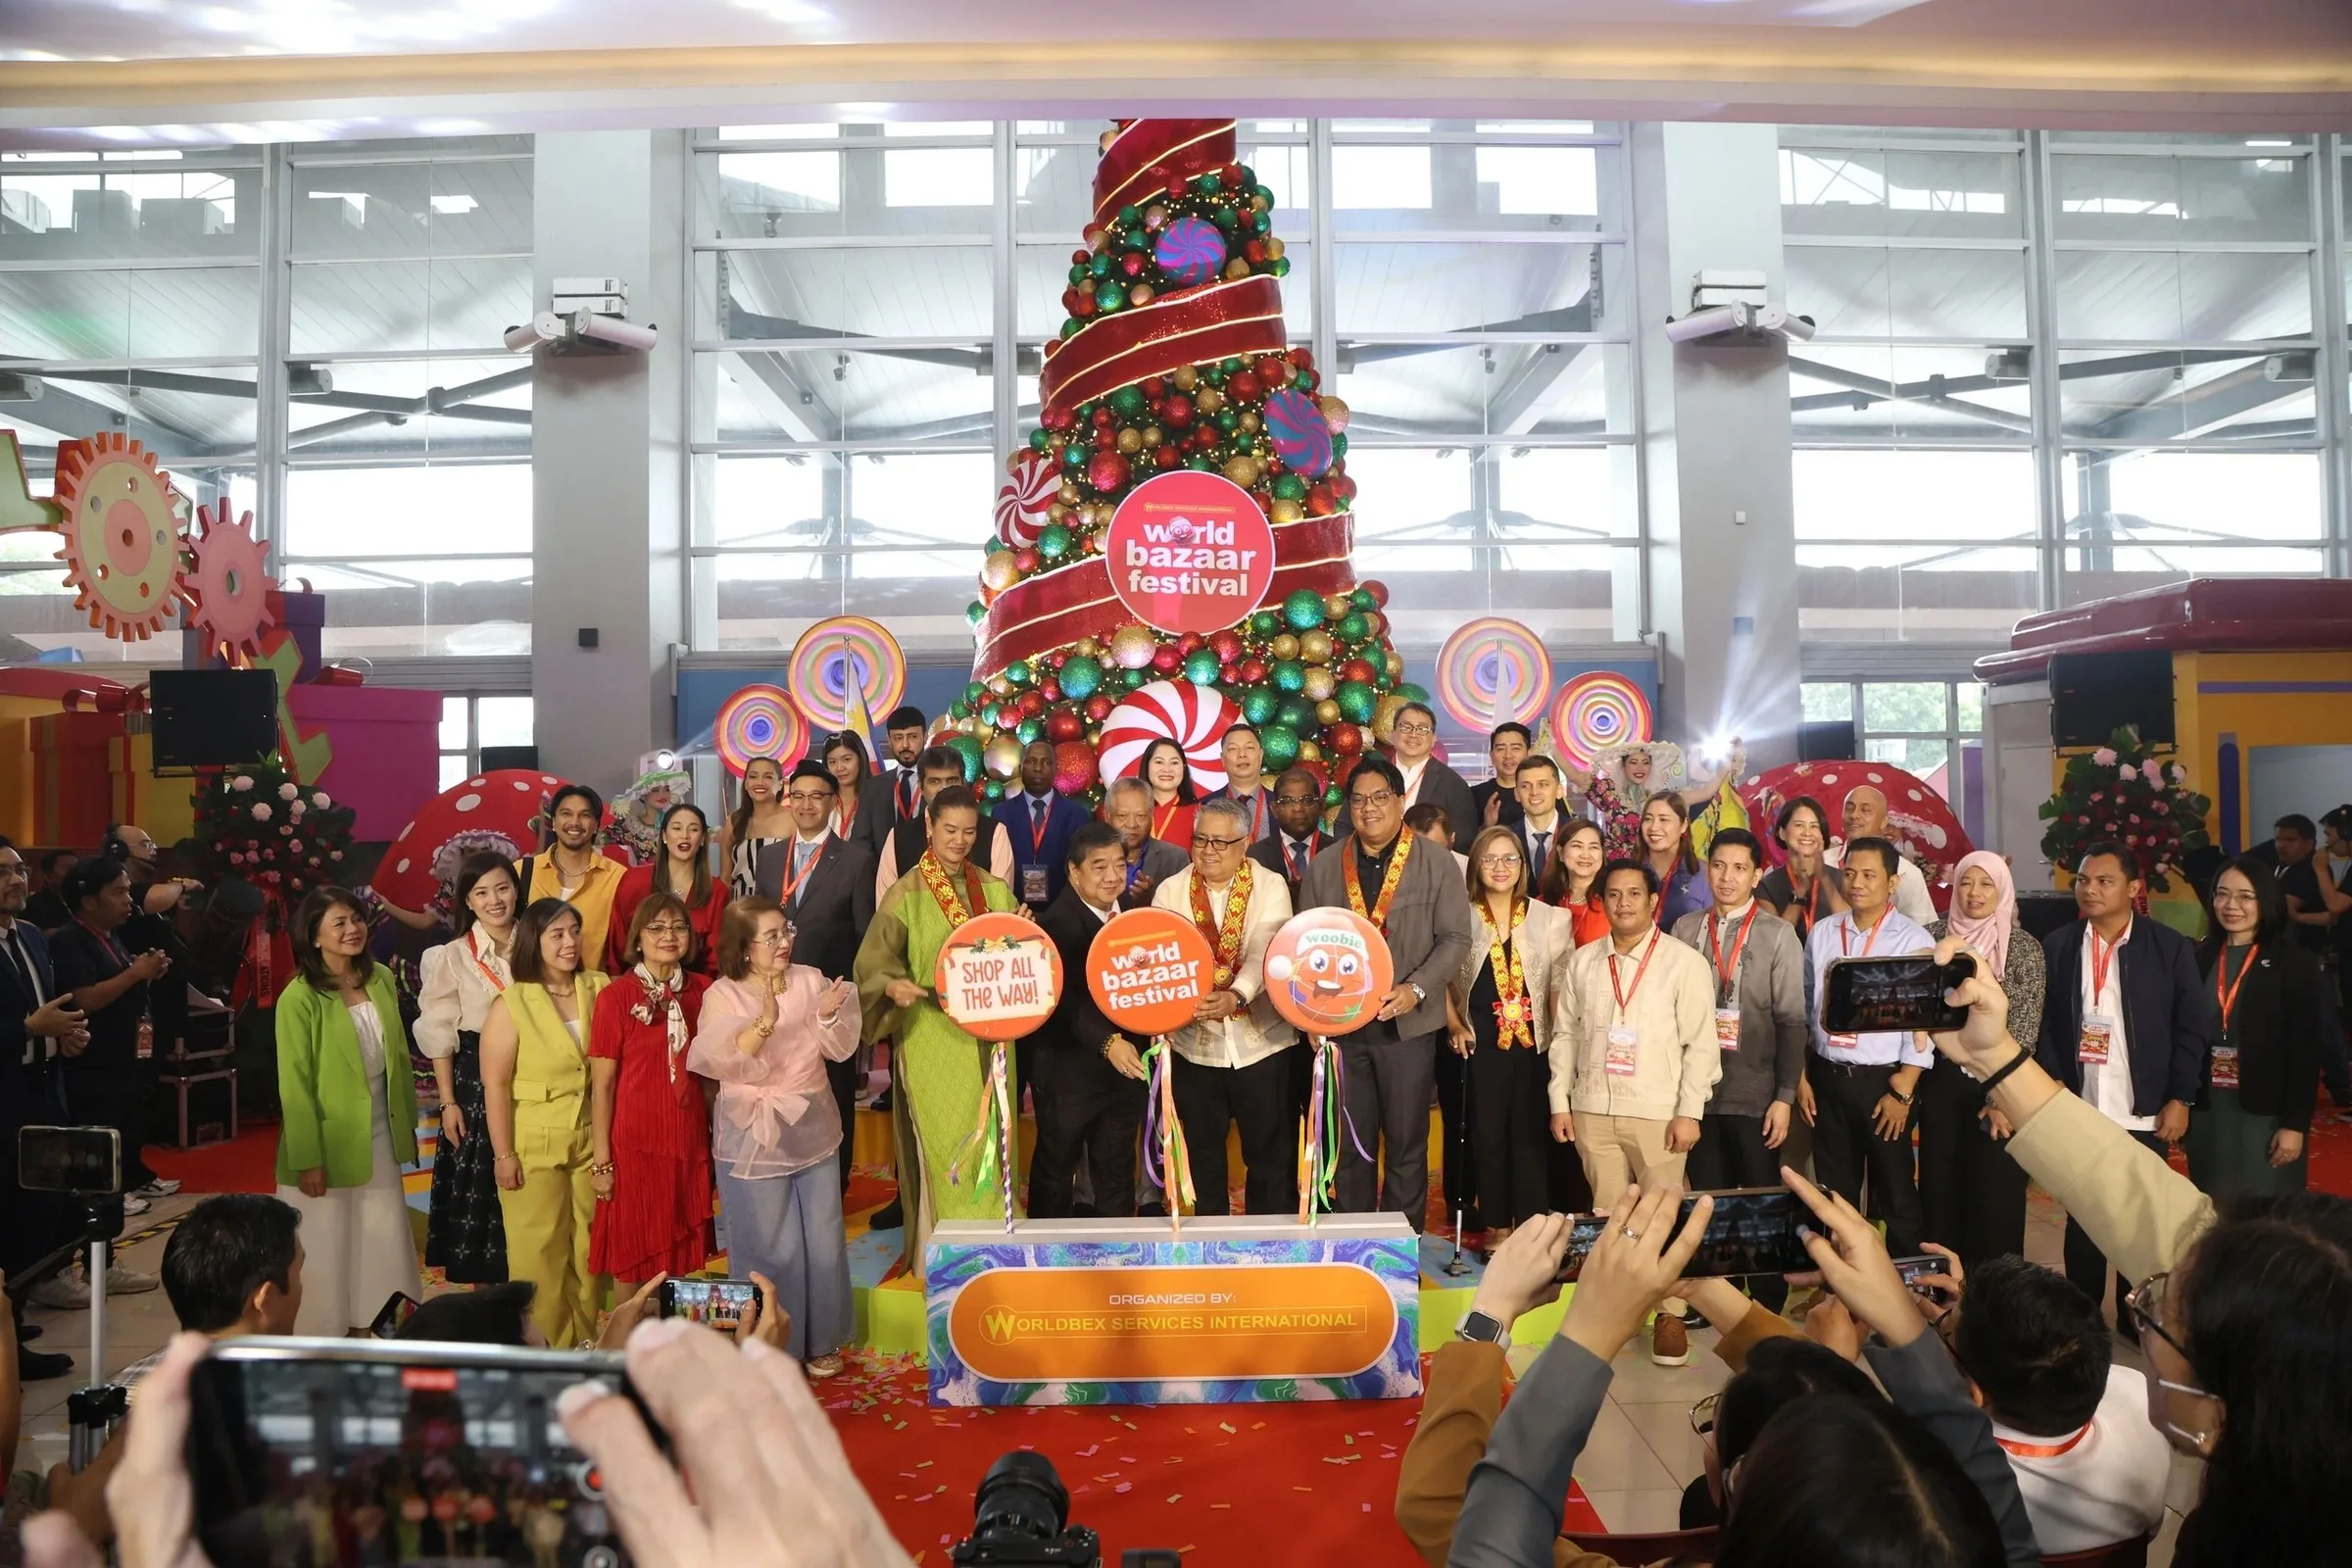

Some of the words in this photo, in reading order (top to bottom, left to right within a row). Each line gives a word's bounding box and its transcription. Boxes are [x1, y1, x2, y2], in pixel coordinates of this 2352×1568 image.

[1143, 517, 1235, 546] world
[1126, 539, 1257, 570] bazaar
[1128, 569, 1248, 596] festival
[1110, 941, 1182, 970] world
[1305, 933, 1362, 949] woobie
[962, 959, 1004, 984] SHOP
[1011, 956, 1036, 979] ALL
[1101, 960, 1200, 992] bazaar
[997, 980, 1039, 1007] WAY!
[1108, 978, 1200, 1010] festival
[1108, 1294, 1206, 1305] ORGANIZED
[1210, 1293, 1237, 1304] BY:
[985, 1309, 1105, 1342] WORLDBEX
[1111, 1316, 1204, 1331] SERVICES
[1210, 1313, 1358, 1329] INTERNATIONAL
